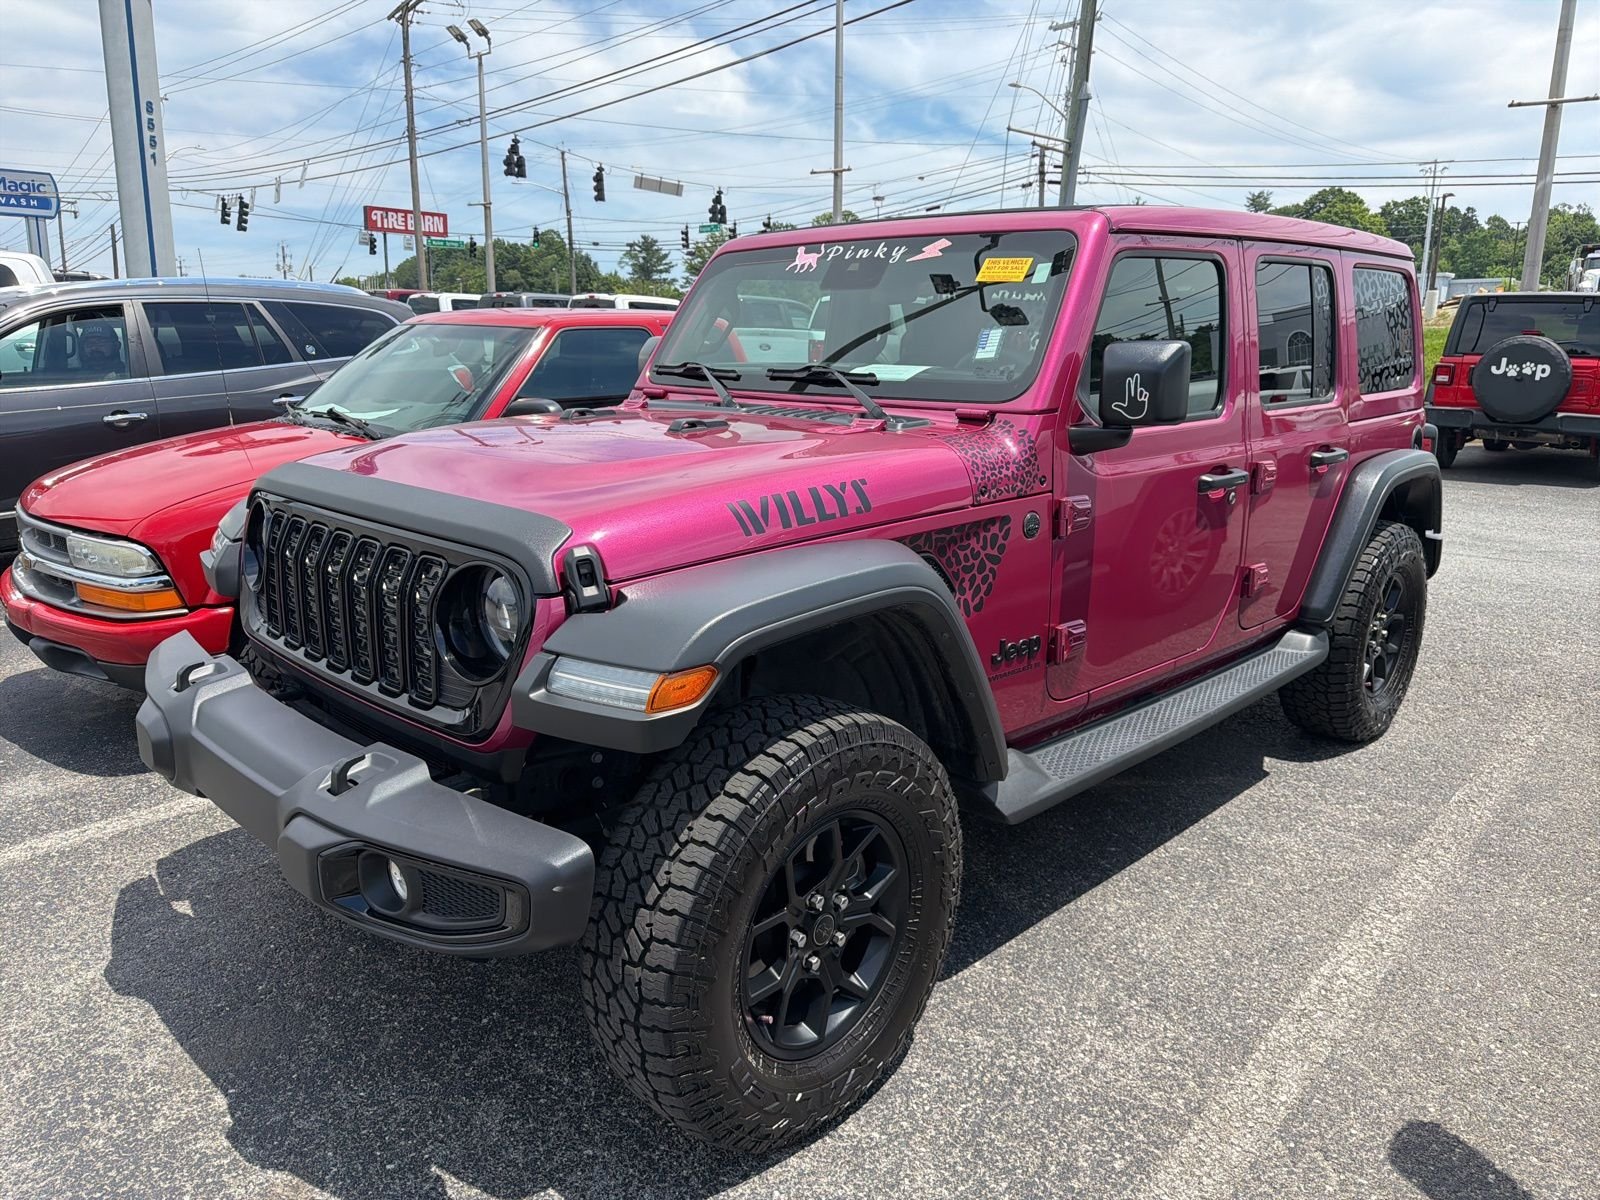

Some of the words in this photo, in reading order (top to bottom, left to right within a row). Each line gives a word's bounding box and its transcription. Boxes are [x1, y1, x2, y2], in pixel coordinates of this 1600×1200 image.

[826, 242, 908, 264] Pinky
[726, 478, 872, 537] WILLYS
[991, 635, 1041, 667] Jeep
